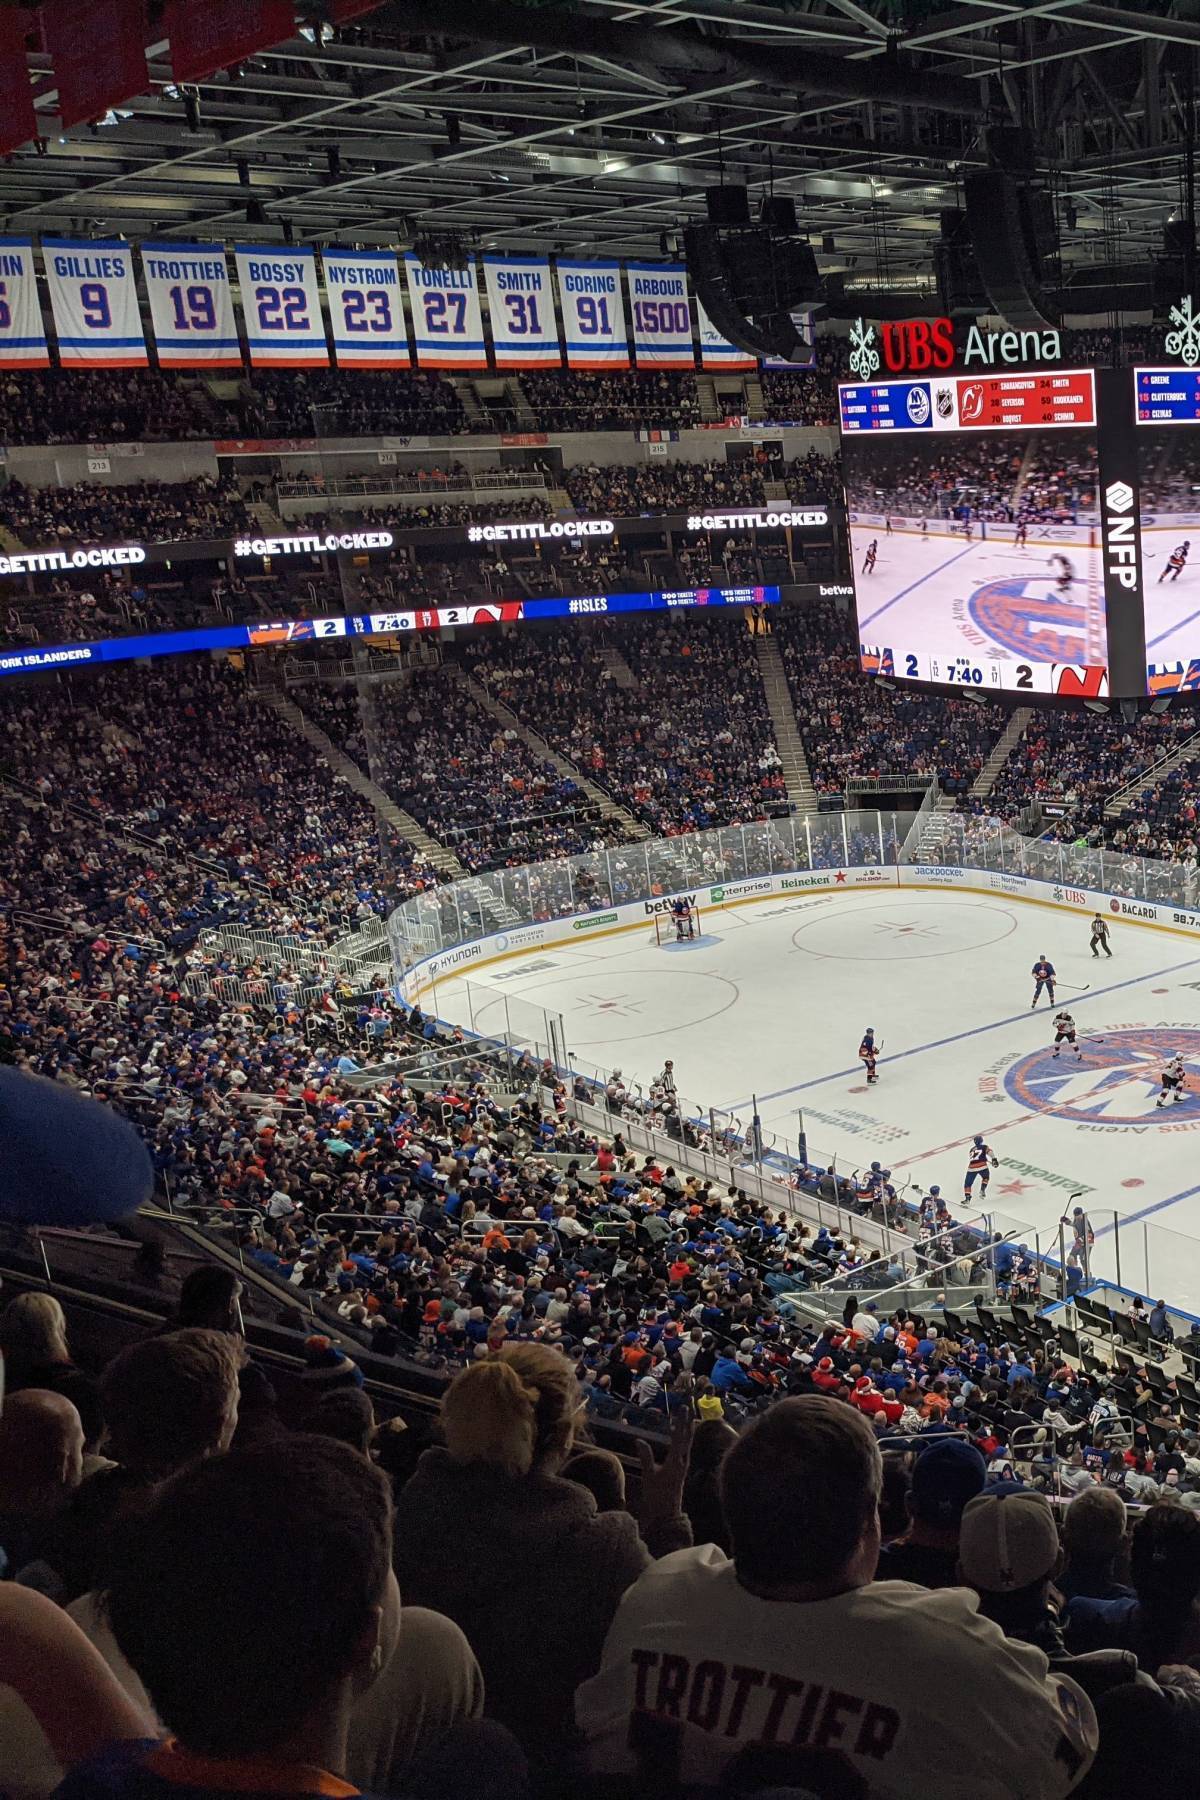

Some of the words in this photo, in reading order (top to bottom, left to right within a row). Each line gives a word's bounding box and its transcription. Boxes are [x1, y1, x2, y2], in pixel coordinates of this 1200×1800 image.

[54, 256, 125, 278] GILLIES
[147, 259, 226, 281] TROTTIER
[249, 262, 305, 283] BOSSY
[328, 265, 397, 285] NYSTROM
[412, 268, 472, 289] TONELLI
[497, 271, 542, 291] SMITH
[565, 275, 616, 294] GORING
[634, 279, 684, 297] ARBOUR
[79, 283, 112, 329] 9
[169, 285, 217, 330] 19
[255, 287, 311, 331] 22
[341, 290, 393, 333] 23
[425, 291, 467, 335] 27
[505, 296, 543, 335] 31
[577, 297, 612, 335] 91
[633, 301, 690, 334] 1500
[881, 316, 956, 373] UBS
[963, 325, 1062, 366] Arena
[990, 382, 999, 390] 17
[1040, 380, 1050, 388] 24
[991, 415, 1001, 423] 70
[1042, 412, 1052, 421] 40
[652, 445, 665, 453] 215
[92, 462, 106, 470] 213
[467, 519, 614, 542] #GETITLOCKED
[687, 510, 828, 532] #GETITLOCKED
[234, 531, 394, 557] #GETITLOCKED
[1106, 517, 1138, 588] NFP
[569, 598, 608, 613] #ISLES
[379, 618, 409, 630] 7:40
[448, 610, 459, 622] 2
[324, 622, 337, 634] 2
[354, 623, 364, 633] 12
[24, 649, 92, 666] ISLANDERS
[906, 654, 919, 677] 2
[933, 665, 939, 677] 12
[947, 665, 983, 684] 7:40
[1016, 665, 1034, 688] 2
[780, 876, 831, 889] Heineken
[1001, 875, 1027, 887] Northwell
[1065, 889, 1086, 905] UBS
[1173, 912, 1196, 926] 98.7
[440, 943, 482, 967] HYUNDAI
[1105, 1022, 1148, 1031] UBS
[984, 1052, 1023, 1081] Arena
[978, 1072, 999, 1095] UBS
[630, 1648, 902, 1760] TROTTIER
